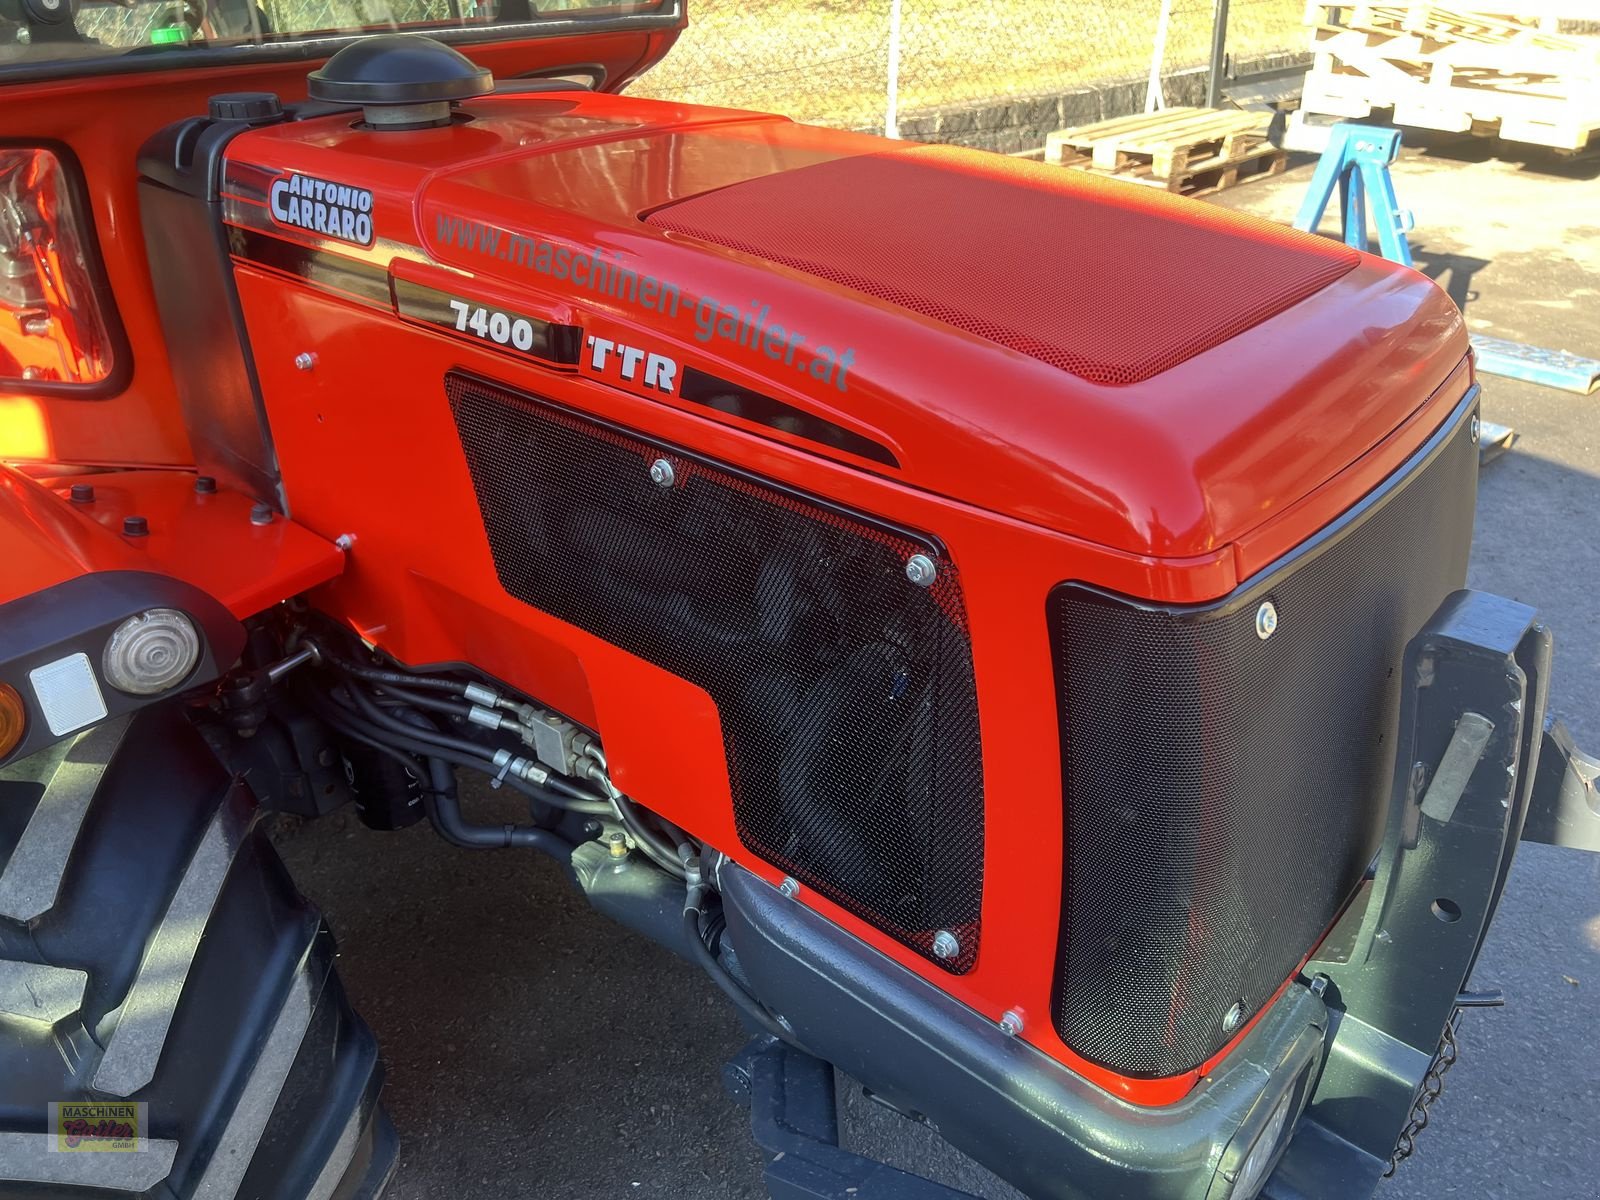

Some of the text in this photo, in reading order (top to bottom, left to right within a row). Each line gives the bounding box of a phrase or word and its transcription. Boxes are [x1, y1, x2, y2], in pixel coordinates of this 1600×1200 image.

[271, 180, 372, 245] CARRARO
[288, 174, 371, 212] ANTONIO
[435, 213, 856, 393] www.maschinen-gailer.at
[450, 300, 534, 351] 7400
[587, 336, 677, 394] TTR
